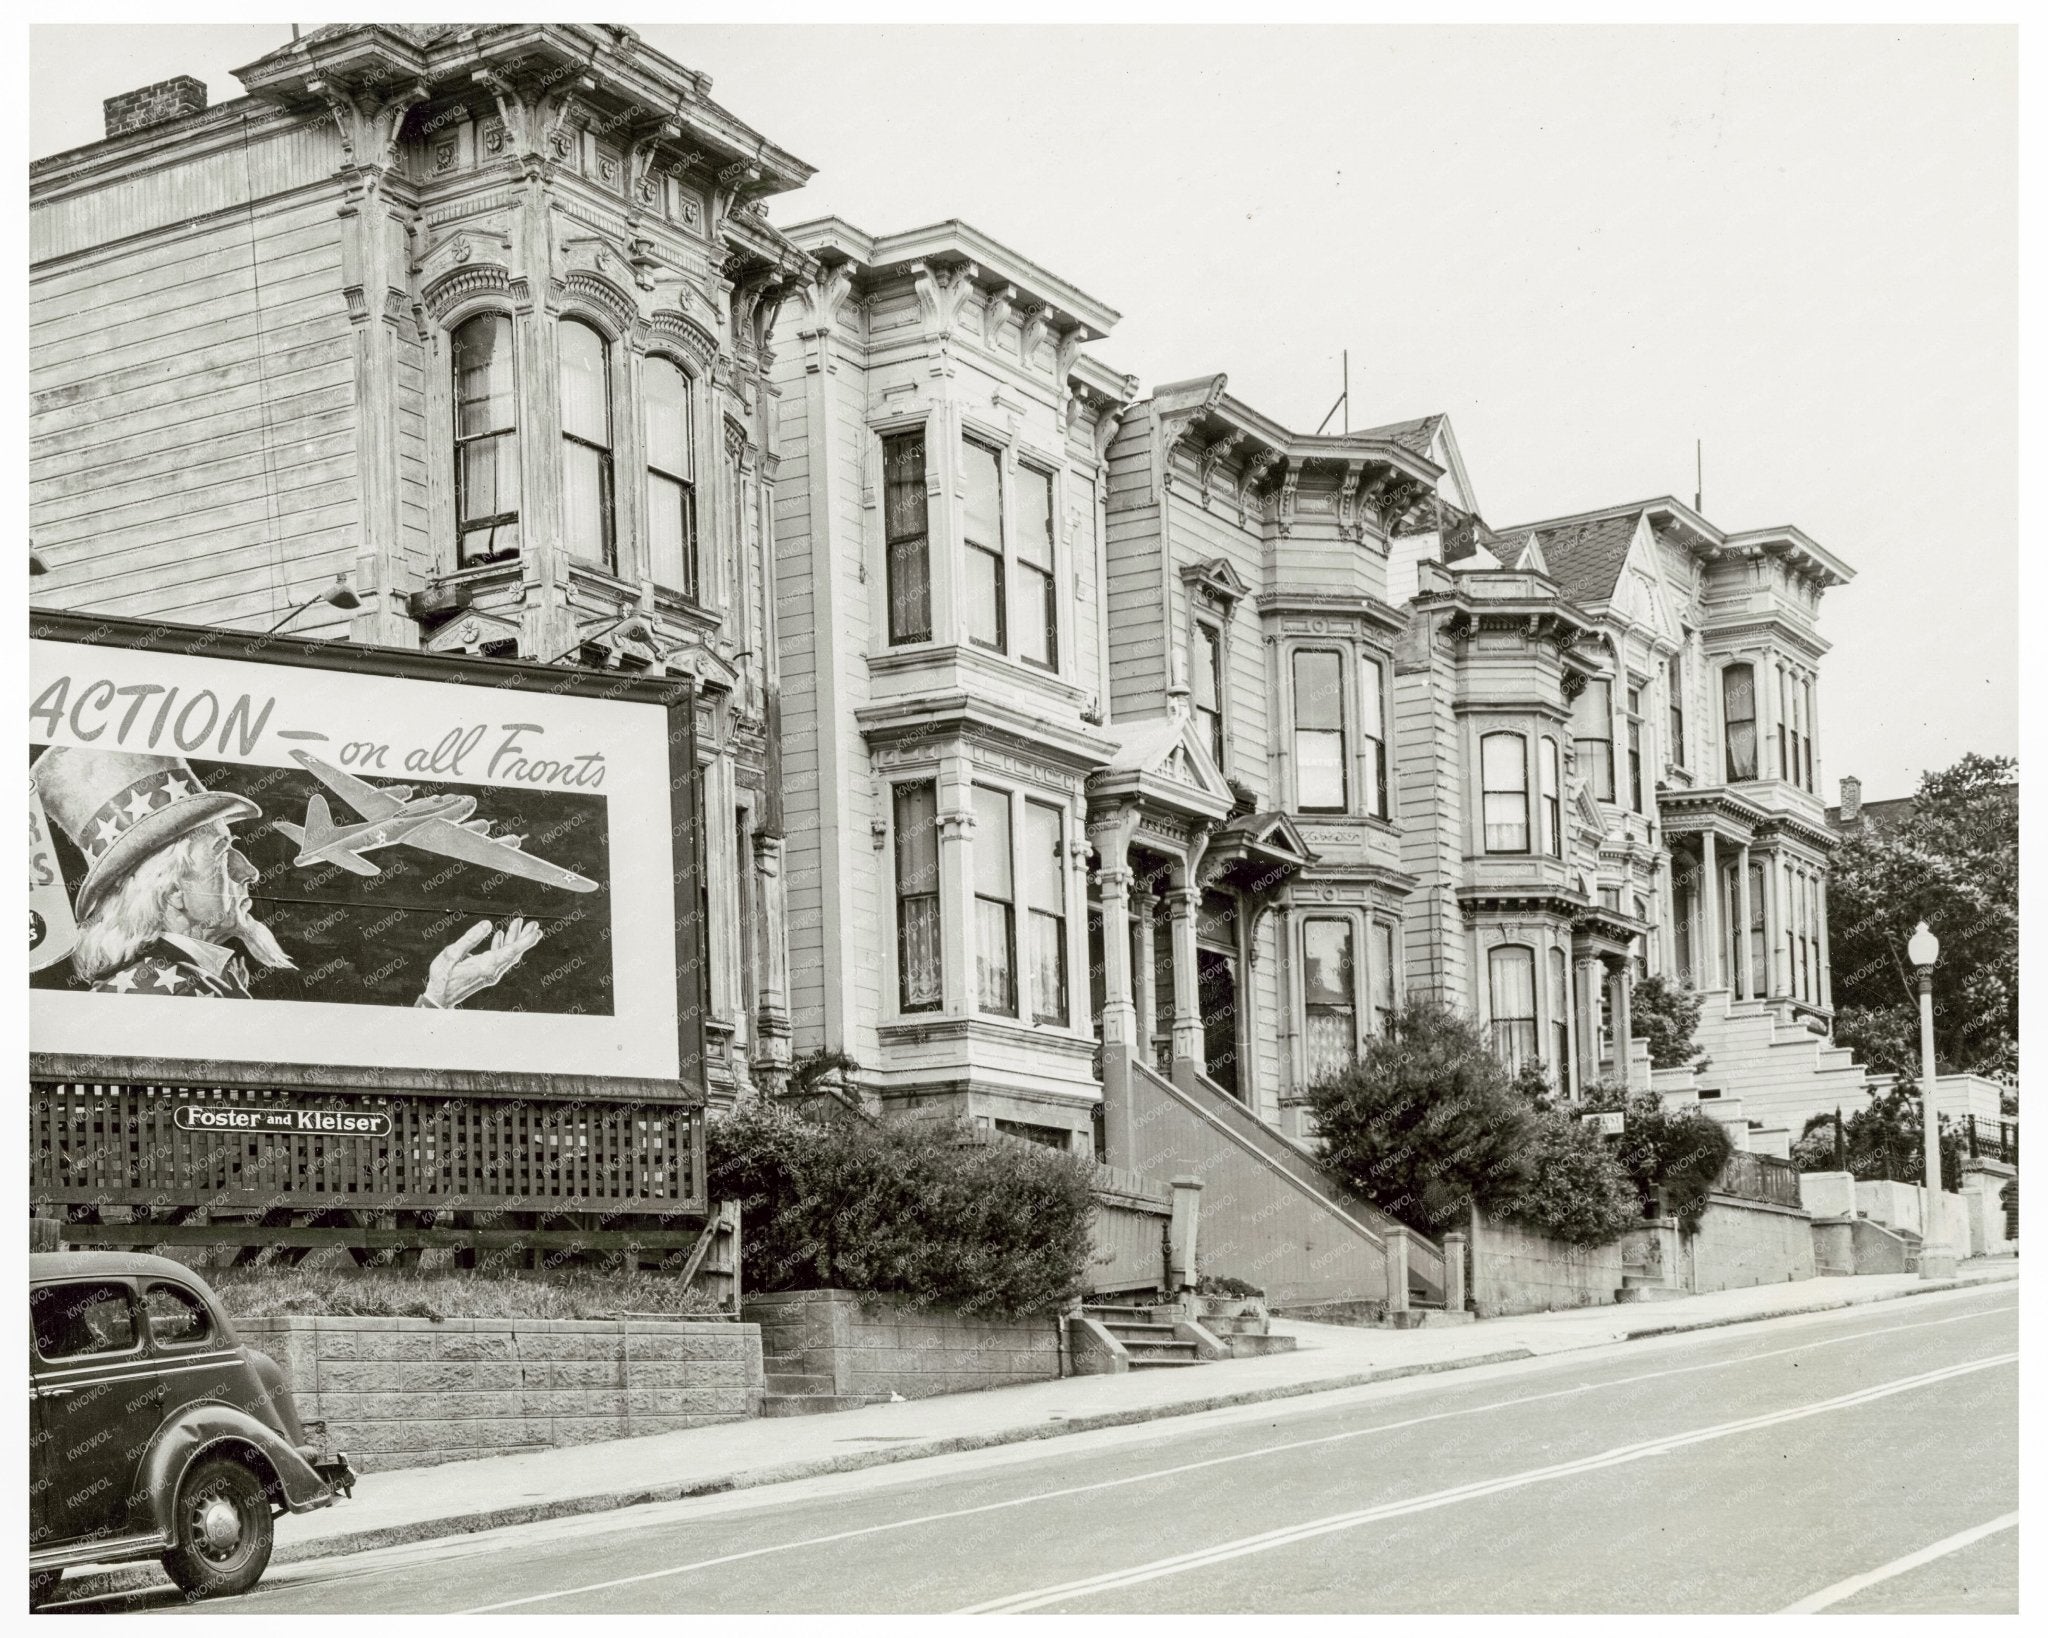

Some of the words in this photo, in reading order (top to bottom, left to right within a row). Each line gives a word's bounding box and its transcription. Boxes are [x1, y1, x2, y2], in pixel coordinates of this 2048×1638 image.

[29, 676, 276, 757] ACTION
[340, 741, 391, 769] on
[404, 724, 488, 777] all
[487, 723, 607, 788] Fronts
[187, 1106, 262, 1127] Foster
[266, 1113, 292, 1126] and
[297, 1110, 381, 1132] Kleiser
